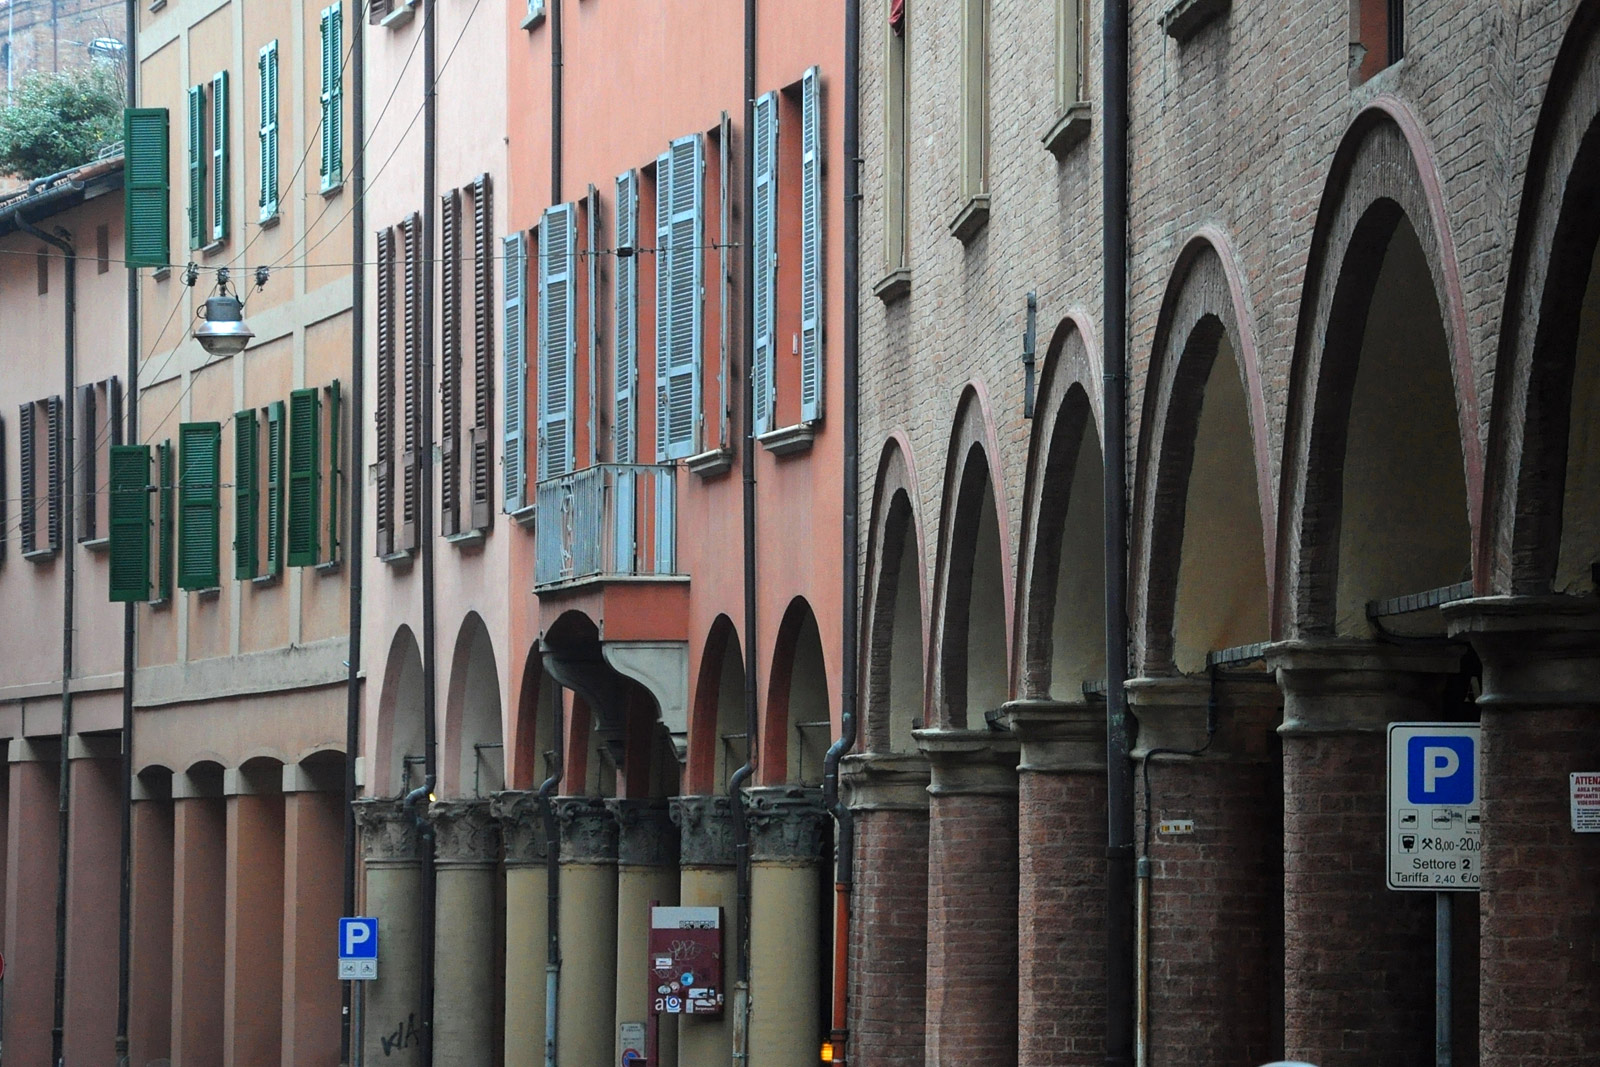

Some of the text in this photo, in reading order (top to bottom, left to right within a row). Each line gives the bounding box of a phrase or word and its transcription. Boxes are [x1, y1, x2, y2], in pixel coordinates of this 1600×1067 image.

[1424, 746, 1459, 793] P
[1412, 858, 1471, 870] Settore 2
[1395, 872, 1480, 884] Tariffa 2,40 €/o
[346, 922, 370, 955] P
